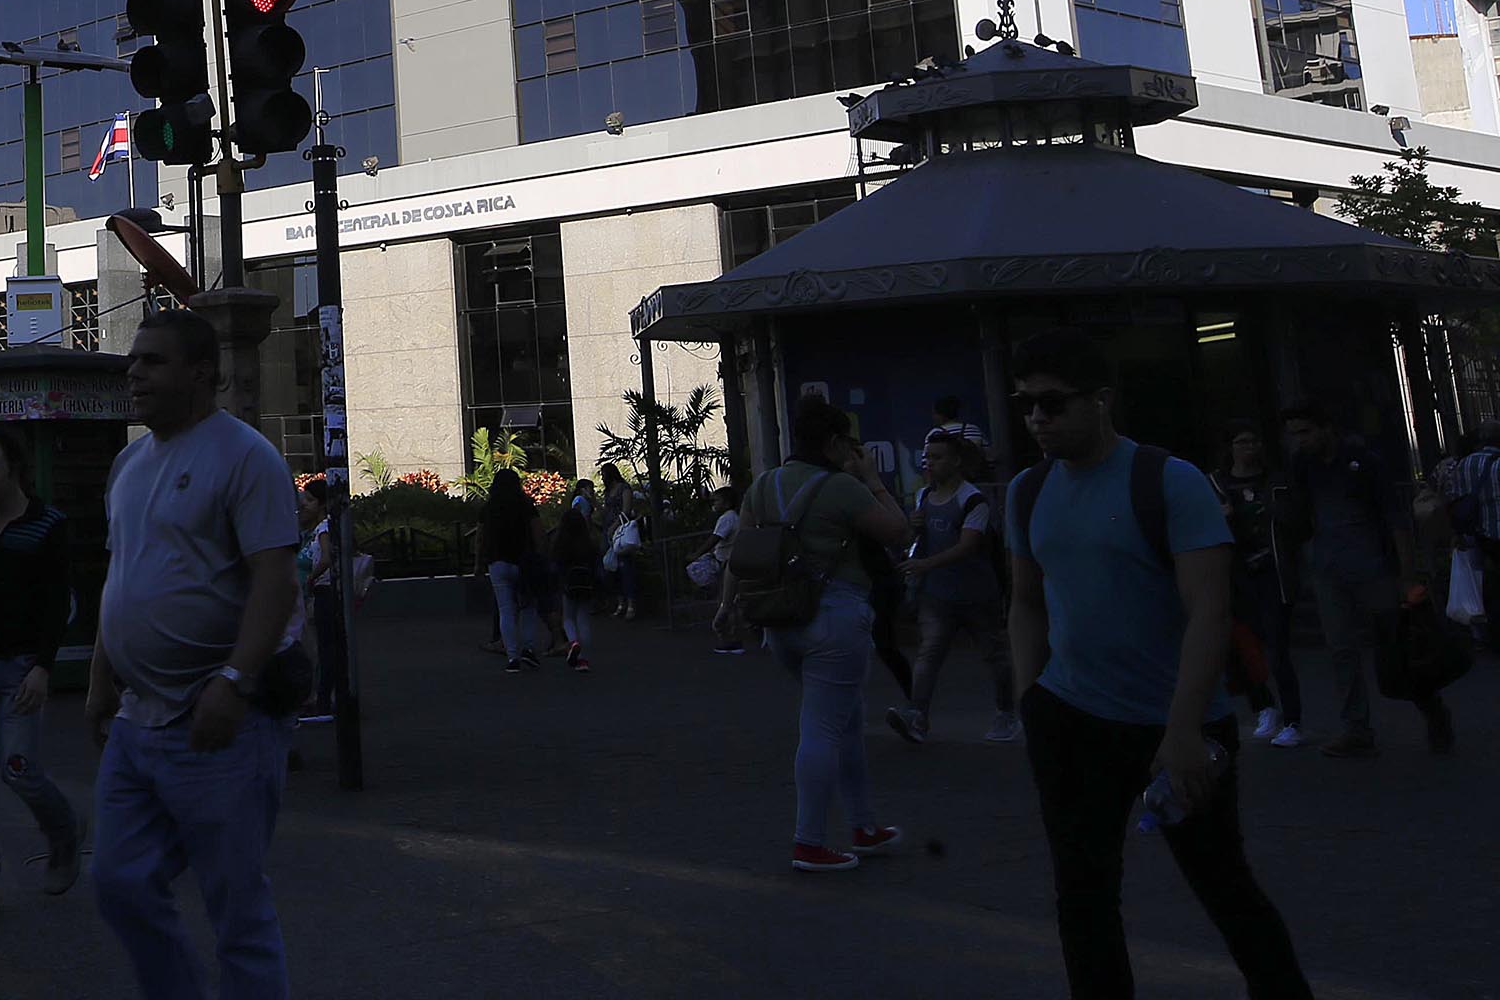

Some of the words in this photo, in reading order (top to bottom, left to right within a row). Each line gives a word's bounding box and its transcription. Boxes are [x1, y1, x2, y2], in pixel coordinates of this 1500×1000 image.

[285, 224, 315, 241] BAN
[403, 208, 422, 225] DE
[425, 201, 474, 221] COSTA
[477, 195, 516, 214] RICA
[9, 379, 38, 393] LOTTO
[61, 399, 104, 413] CHANCES
